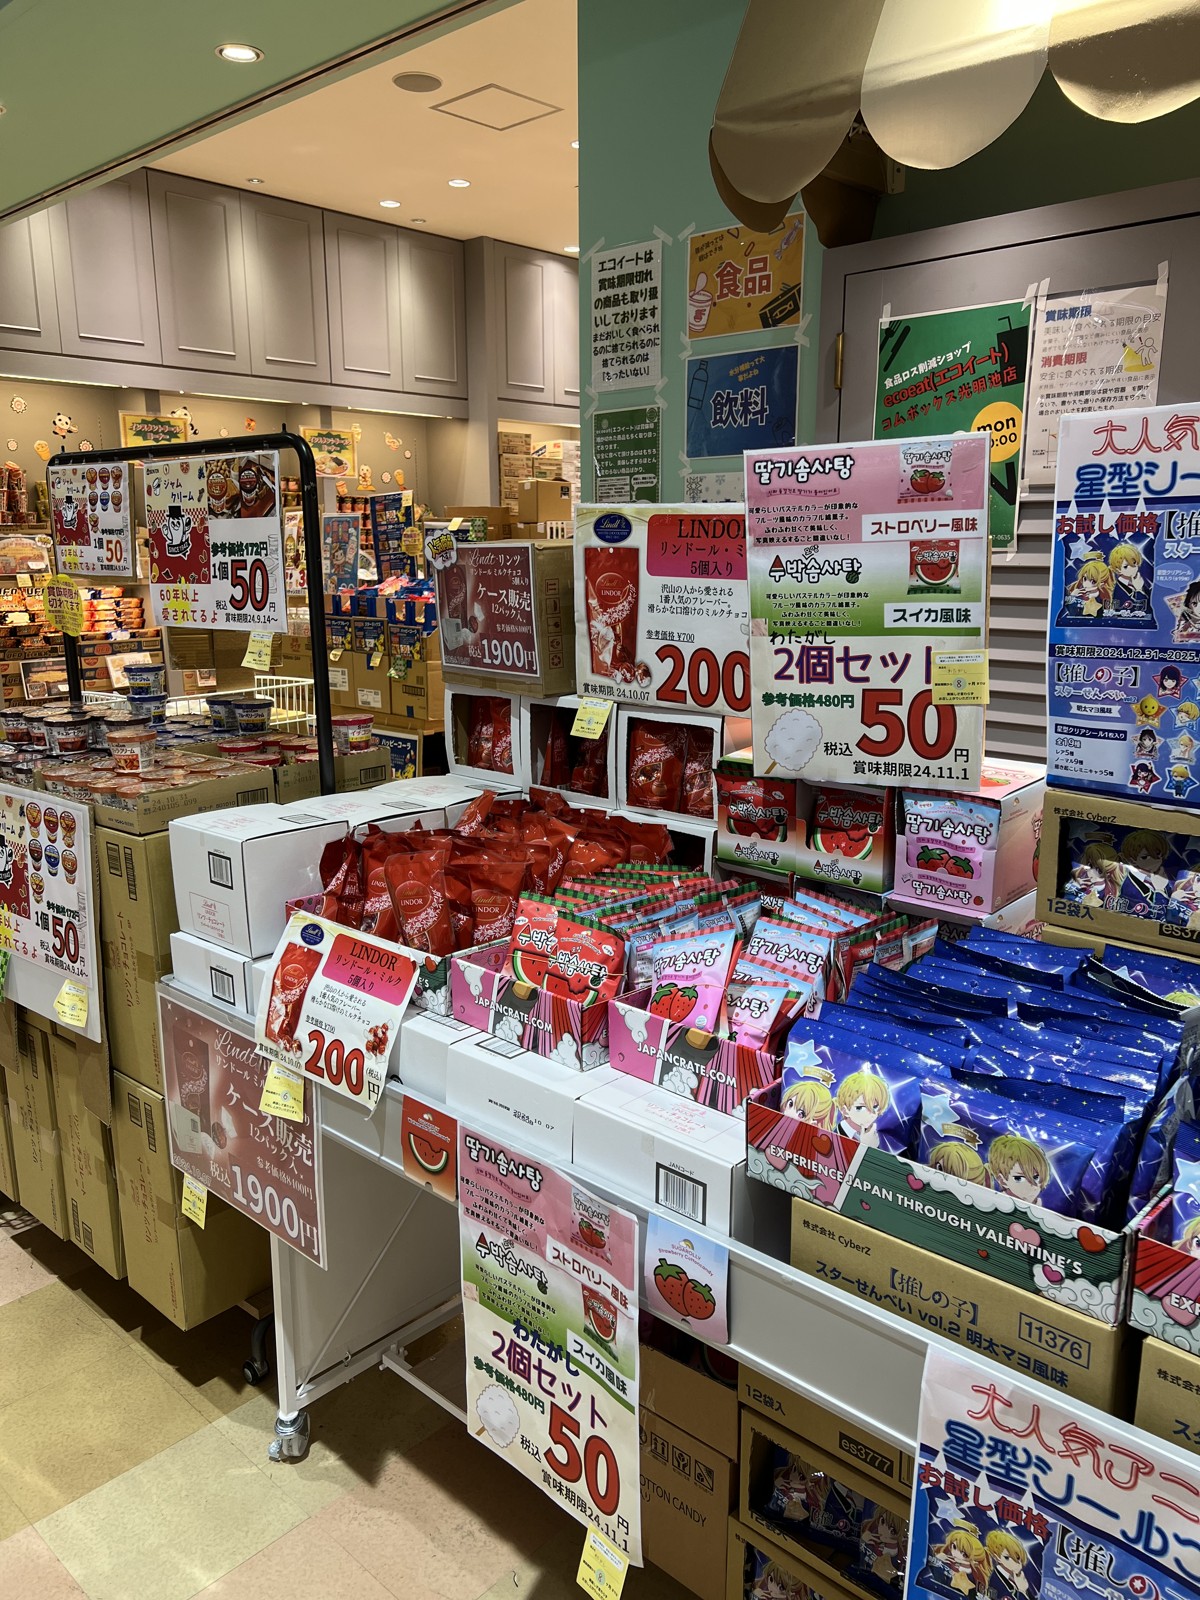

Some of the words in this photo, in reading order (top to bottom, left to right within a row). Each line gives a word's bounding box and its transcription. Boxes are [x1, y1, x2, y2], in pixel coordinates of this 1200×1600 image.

[598, 249, 654, 273] エコイートは
[598, 269, 654, 292] 賞味期限切れ
[713, 254, 773, 302] 食品
[594, 286, 659, 311] の商品も取り扱
[594, 305, 659, 329] いしております
[1045, 304, 1093, 323] 賞味期限
[592, 322, 660, 343] まだおいしく食べられ
[592, 337, 660, 357] るのに捨てられるのに
[602, 352, 650, 368] 捨てられるのは
[1040, 351, 1088, 369] 消費期限
[883, 340, 972, 390] 食品ロス削減ショップ
[883, 342, 1010, 408] ecoeat(エコイート)
[1040, 364, 1124, 381] 安全に食べられる期限
[710, 385, 770, 429] 飲料
[881, 366, 1018, 431] コムボックス光明池店
[976, 415, 1017, 433] mon
[1091, 413, 1200, 457] 大人気
[753, 454, 855, 485] 딸기솜사탕
[163, 478, 183, 490] ジャム
[171, 490, 195, 503] クリーム
[870, 516, 979, 536] ストロベリー風味
[1056, 511, 1160, 536] お試し価格
[93, 537, 104, 549] 1個
[105, 539, 123, 563] 50
[210, 541, 269, 558] 参考価格172円
[690, 560, 734, 577] 5個入り
[768, 554, 863, 585] 수박솜사탕
[160, 589, 199, 603] 60年以上
[211, 561, 229, 581] 1個
[229, 558, 270, 611] 50
[477, 582, 531, 611] ケース販売
[661, 583, 734, 597] 沢山の人から愛される
[215, 600, 228, 611] 税込
[268, 602, 276, 613] 円
[647, 603, 748, 619] 滑らかな口溶けのミルクチョコ
[659, 595, 731, 609] 1番人気のフレーバー。
[161, 607, 218, 624] 愛されてるよ
[892, 607, 973, 624] スイカ風味
[646, 629, 675, 641] 参考価格
[676, 632, 695, 643] ¥700
[769, 628, 837, 645] わたがし
[468, 644, 482, 659] 税込
[481, 638, 537, 671] 1900円
[655, 644, 750, 713] 200
[1054, 662, 1141, 688] 【推しの子】
[582, 682, 615, 697] 賞味期限
[616, 687, 650, 702] 24.10.07
[761, 692, 855, 709] 参考価格480円
[1054, 685, 1126, 701] スターせんべい
[1076, 704, 1113, 714] 明太マヨ風味
[823, 741, 854, 757] 税込
[855, 688, 958, 761] 50
[954, 748, 970, 763] 円
[381, 738, 411, 750] ハッピーコーラ
[852, 760, 970, 781] 賞味期限24.11.1
[905, 812, 991, 845] 딸기솜사탕
[1053, 807, 1085, 818] 株式会社
[1086, 812, 1117, 824] CyberZ
[400, 898, 424, 906] LINDOR
[911, 879, 972, 905] 딸기솜사탕
[1047, 898, 1095, 921] 12袋入
[35, 911, 50, 932] 1個
[52, 915, 80, 965] 50
[40, 940, 51, 953] 税込
[79, 955, 86, 968] 円
[349, 941, 398, 972] LINDOR
[653, 949, 721, 979] 딸기솜사탕
[750, 937, 825, 974] 딸기솜사탕
[335, 954, 402, 987] リンドール・ミルク
[347, 975, 375, 992] 5個入り
[474, 994, 554, 1035] JAPANCRATE.COM
[215, 1057, 252, 1081] リンドール
[279, 1053, 303, 1070] 24.10.07
[304, 1029, 365, 1096] 200
[365, 1067, 382, 1082] (税込)
[636, 1042, 738, 1089] JAPANCRATE.COM
[368, 1080, 380, 1103] 円
[226, 1082, 314, 1168] ケース販売
[464, 1134, 544, 1193] 딸기솜사탕
[668, 1161, 695, 1176] JANコード
[768, 1144, 845, 1183] EXPERIENCE
[844, 1175, 895, 1203] JAPAN
[896, 1193, 973, 1233] THROUGH
[209, 1160, 231, 1188] 税込
[232, 1164, 320, 1257] 1900円
[801, 1217, 837, 1243] 株式会社
[837, 1234, 872, 1257] CyberZ
[476, 1232, 549, 1291] 수박솜사탕
[658, 1248, 685, 1259] Strawberry
[671, 1243, 702, 1261] SUGAROLLY
[551, 1245, 630, 1311] ストロベリー風味
[887, 1266, 980, 1327] 【推しの子】
[815, 1259, 914, 1316] スターせんべい
[917, 1311, 961, 1337] vol.2
[965, 1327, 1070, 1390] 明太マヨ風味
[512, 1317, 580, 1377] わたがし
[1022, 1319, 1084, 1362] 11376
[491, 1330, 608, 1430] 2個セット
[572, 1338, 628, 1396] スイカ風味
[473, 1355, 546, 1415] 参考価格480円
[745, 1383, 787, 1417] 12袋入
[841, 1437, 892, 1473] es3777
[519, 1433, 543, 1464] 税込
[543, 1400, 621, 1517] 50
[616, 1513, 630, 1537] 円
[541, 1468, 630, 1554] 賞味期限24.11.1
[672, 1496, 707, 1528] CANDY
[919, 1461, 1053, 1540] お試し価格
